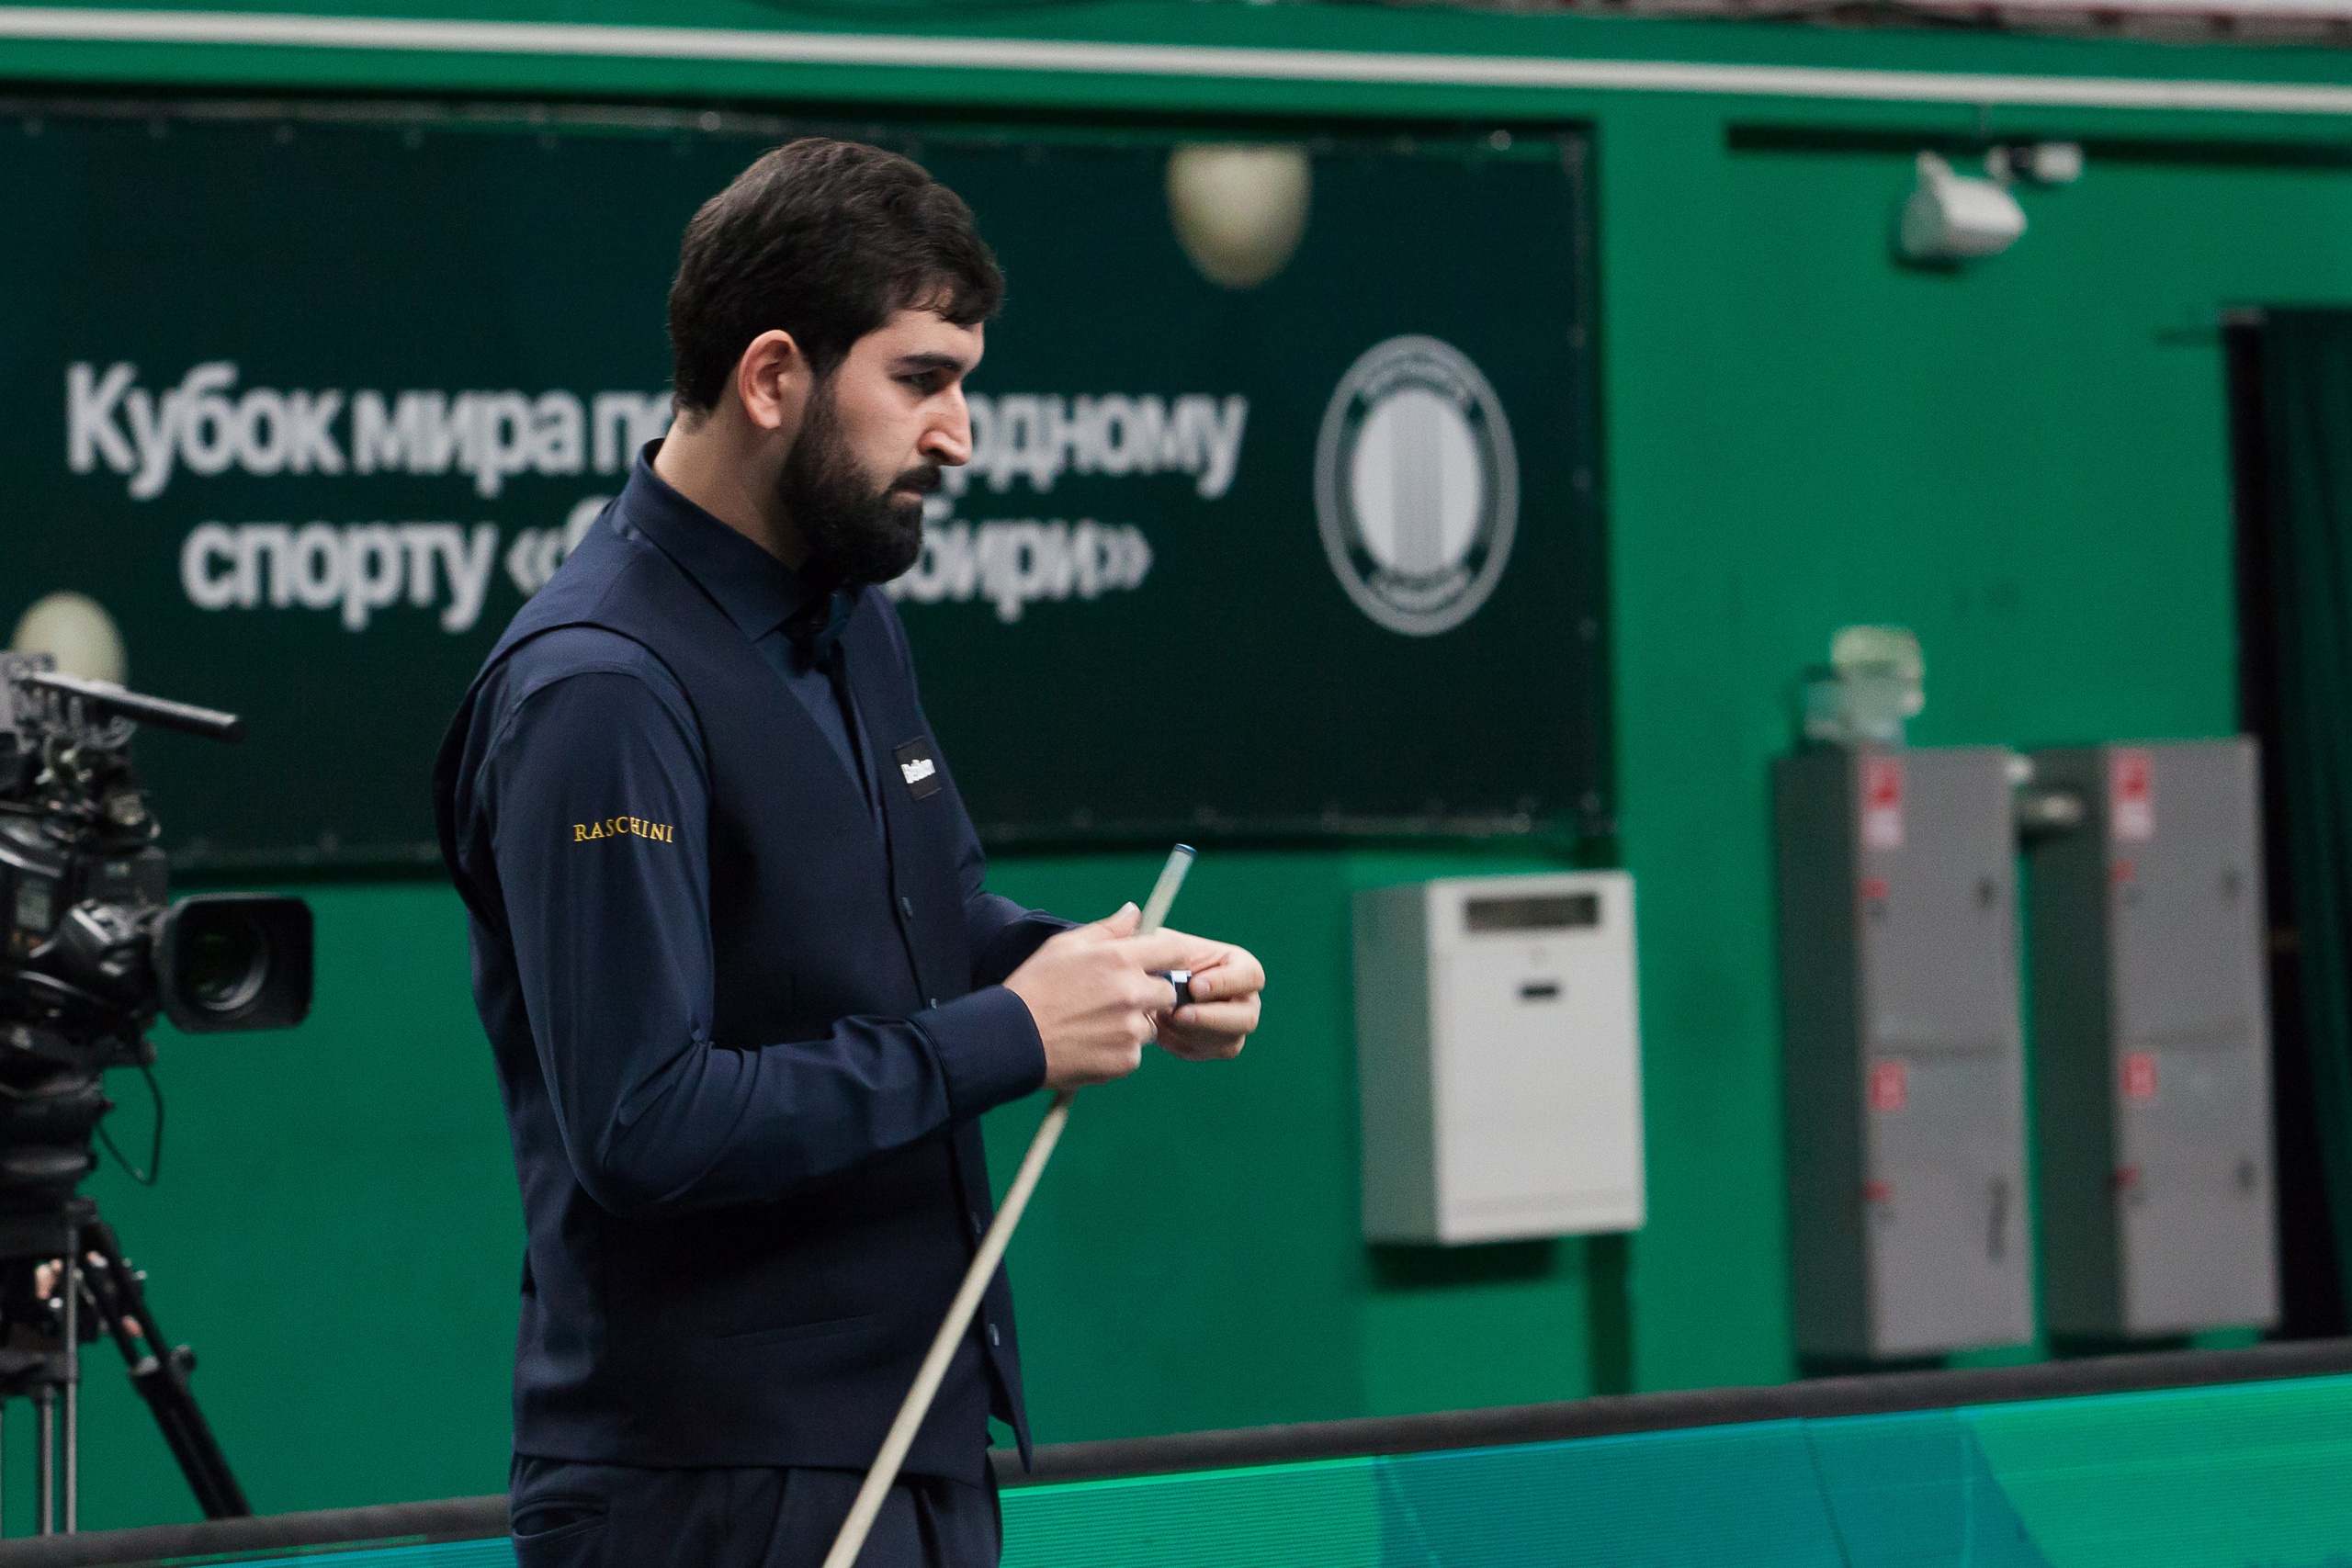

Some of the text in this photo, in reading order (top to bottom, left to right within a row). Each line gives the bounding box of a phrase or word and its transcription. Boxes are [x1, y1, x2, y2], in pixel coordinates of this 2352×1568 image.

[68, 363, 345, 499] Кубок
[353, 389, 584, 497] мира
[181, 522, 498, 631] спорту
[573, 817, 673, 842] RASCHINI
